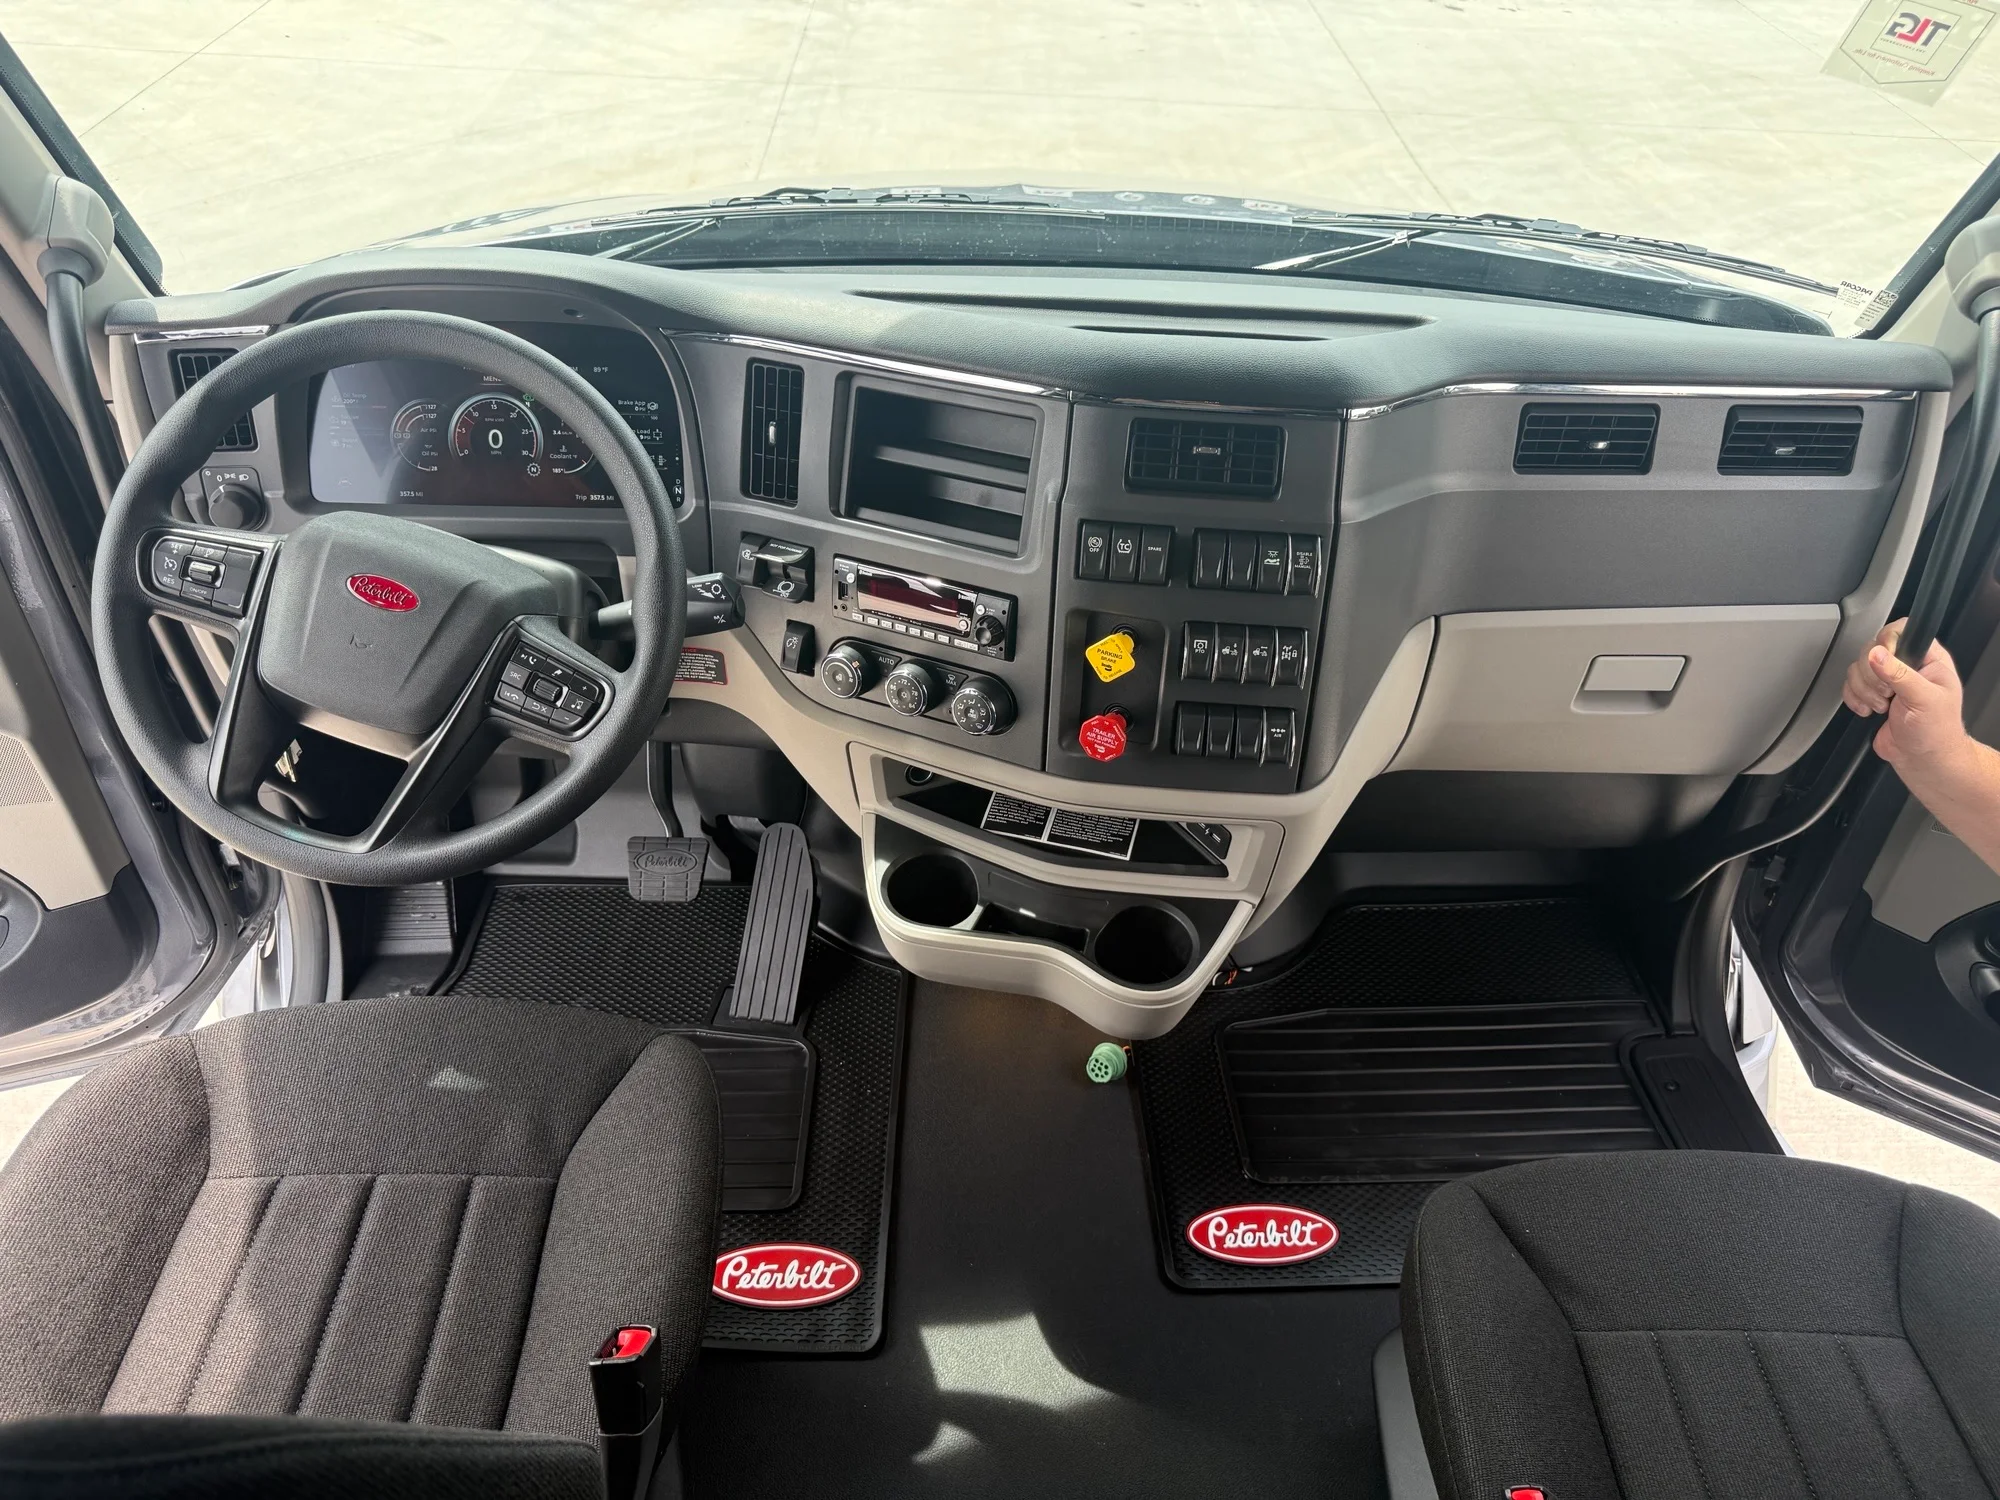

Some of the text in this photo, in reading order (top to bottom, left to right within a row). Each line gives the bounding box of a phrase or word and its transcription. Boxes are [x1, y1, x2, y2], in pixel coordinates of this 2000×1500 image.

[488, 429, 503, 449] 0
[1120, 543, 1130, 551] TC
[163, 576, 175, 585] RES
[190, 586, 207, 595] ON/OFF
[353, 576, 412, 606] Peterbilt
[1096, 648, 1123, 660] PARKING
[1100, 655, 1117, 664] BRAKE
[878, 656, 895, 666] AUTO
[509, 671, 522, 681] SRC
[945, 679, 957, 687] MAX
[1092, 727, 1116, 739] TRAILER
[1096, 734, 1119, 746] SUPPLY
[645, 854, 688, 868] Peterbilt
[1207, 1216, 1323, 1250] Peterbilt
[721, 1255, 847, 1290] Peterbilt
